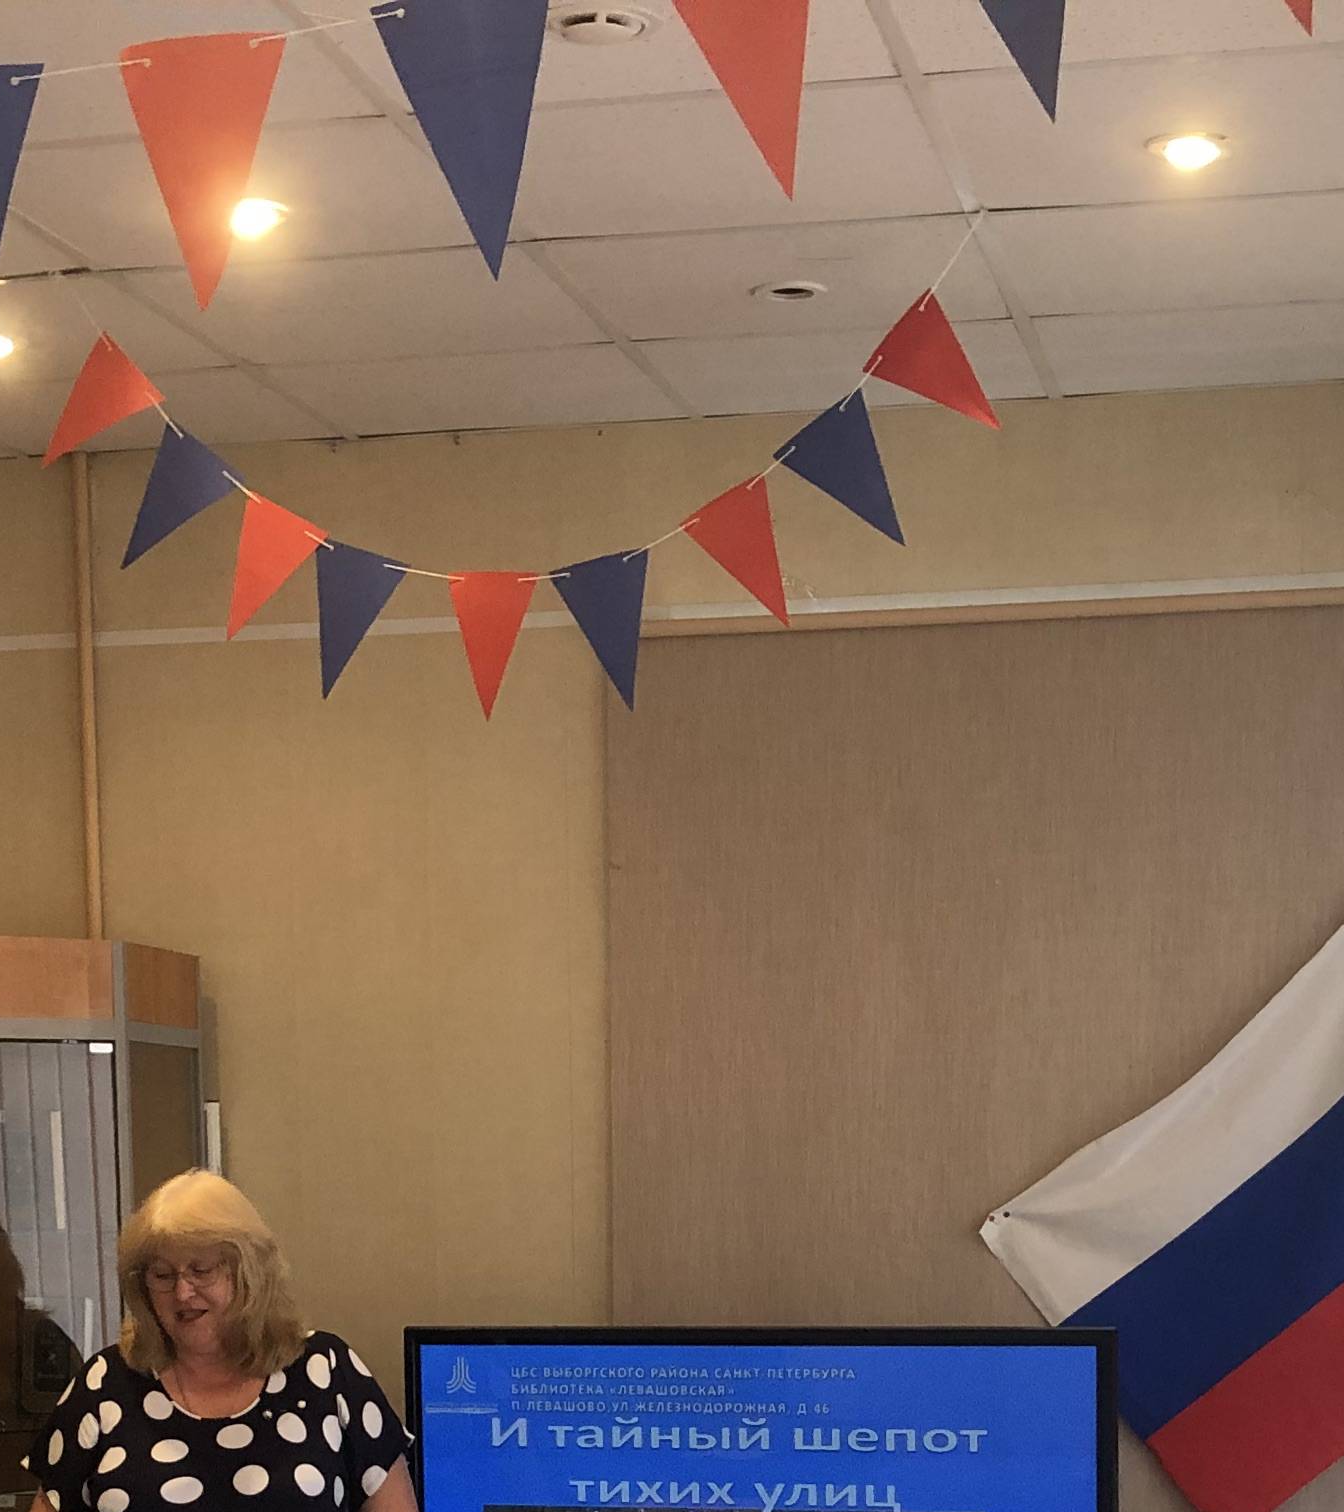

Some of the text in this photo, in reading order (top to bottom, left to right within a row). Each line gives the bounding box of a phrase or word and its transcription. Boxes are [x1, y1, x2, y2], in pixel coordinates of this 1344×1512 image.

[511, 1366, 538, 1379] ЦБС
[543, 1366, 645, 1379] ВЫБОРГСКОГО
[650, 1365, 709, 1379] РАЙОНА
[510, 1382, 735, 1397] БИБЛИОТЕКА «ЛЕВАШОВСКАЯ»
[490, 1416, 988, 1453] И тайный шепот
[569, 1479, 735, 1506] тихих
